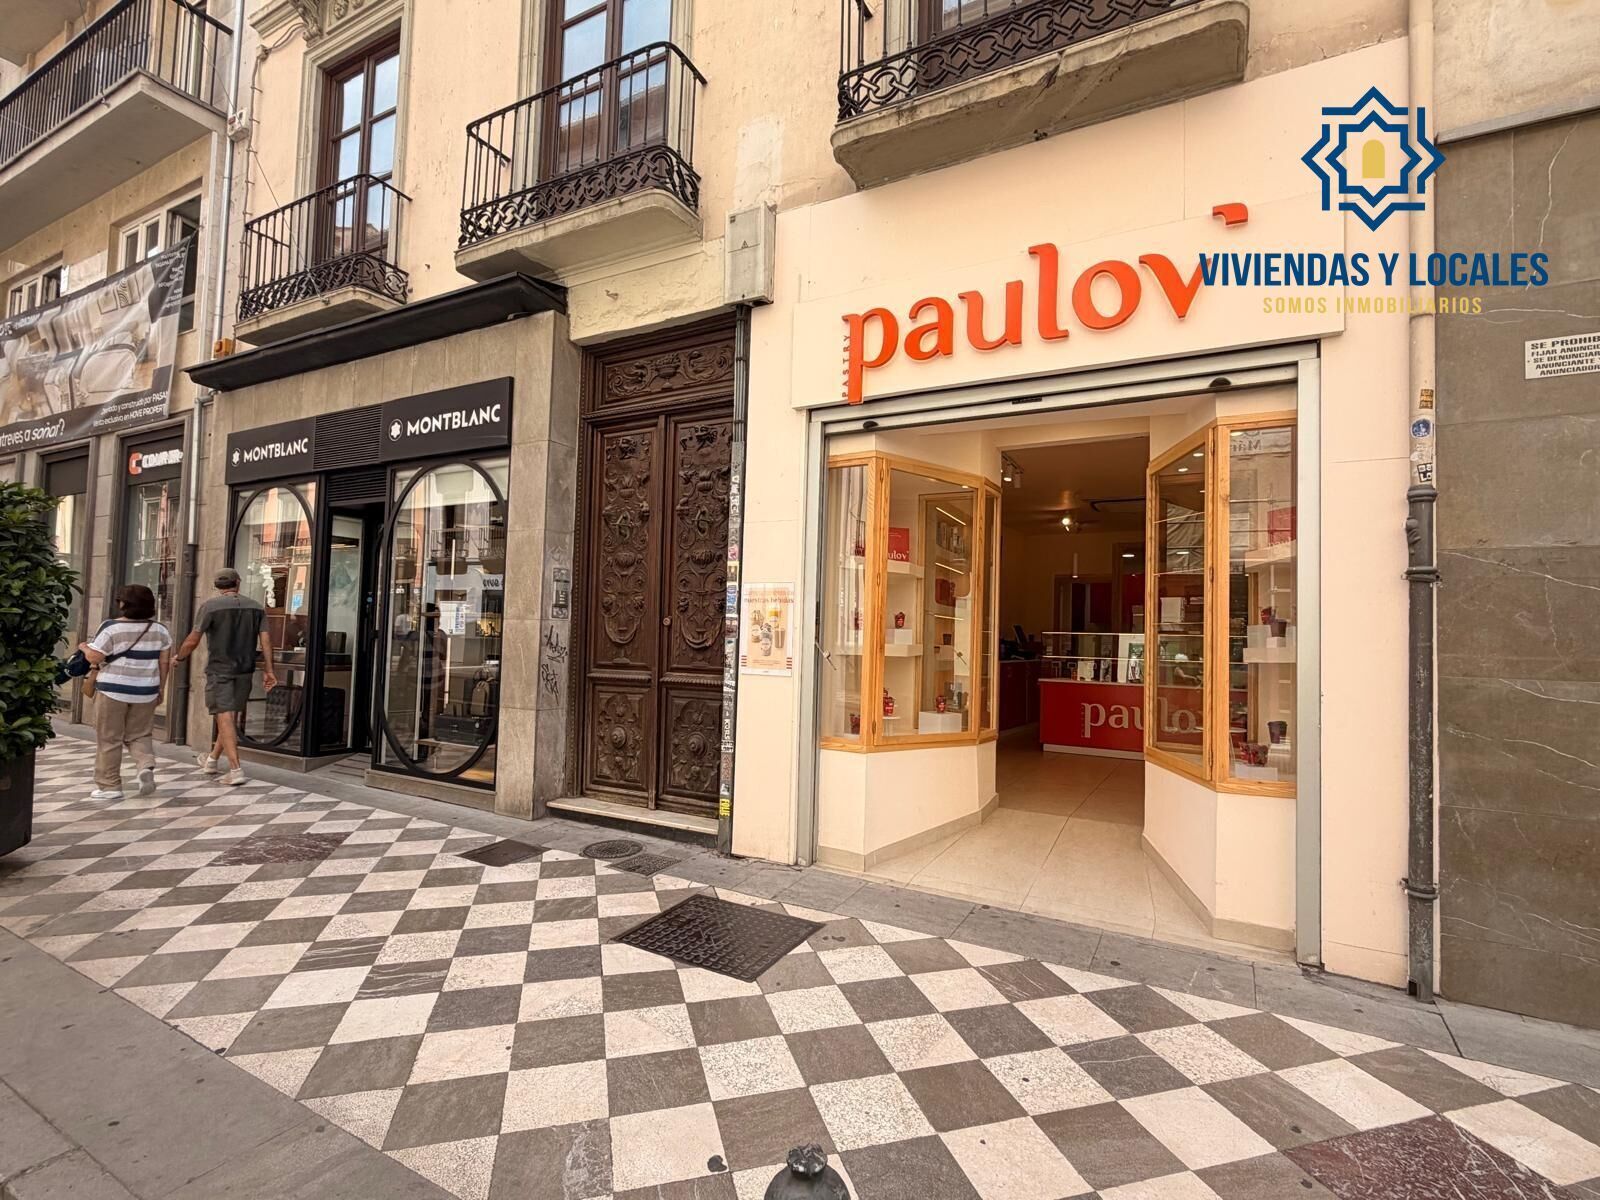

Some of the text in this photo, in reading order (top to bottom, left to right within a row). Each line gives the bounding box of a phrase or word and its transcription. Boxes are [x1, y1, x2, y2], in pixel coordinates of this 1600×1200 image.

[1530, 342, 1547, 350] SE
[1531, 349, 1557, 357] FIJAR
[1535, 358, 1596, 370] ANUNCIANTE
[406, 403, 501, 437] MONTBLANC
[24, 429, 31, 442] a
[243, 437, 309, 464] MONTBLANC
